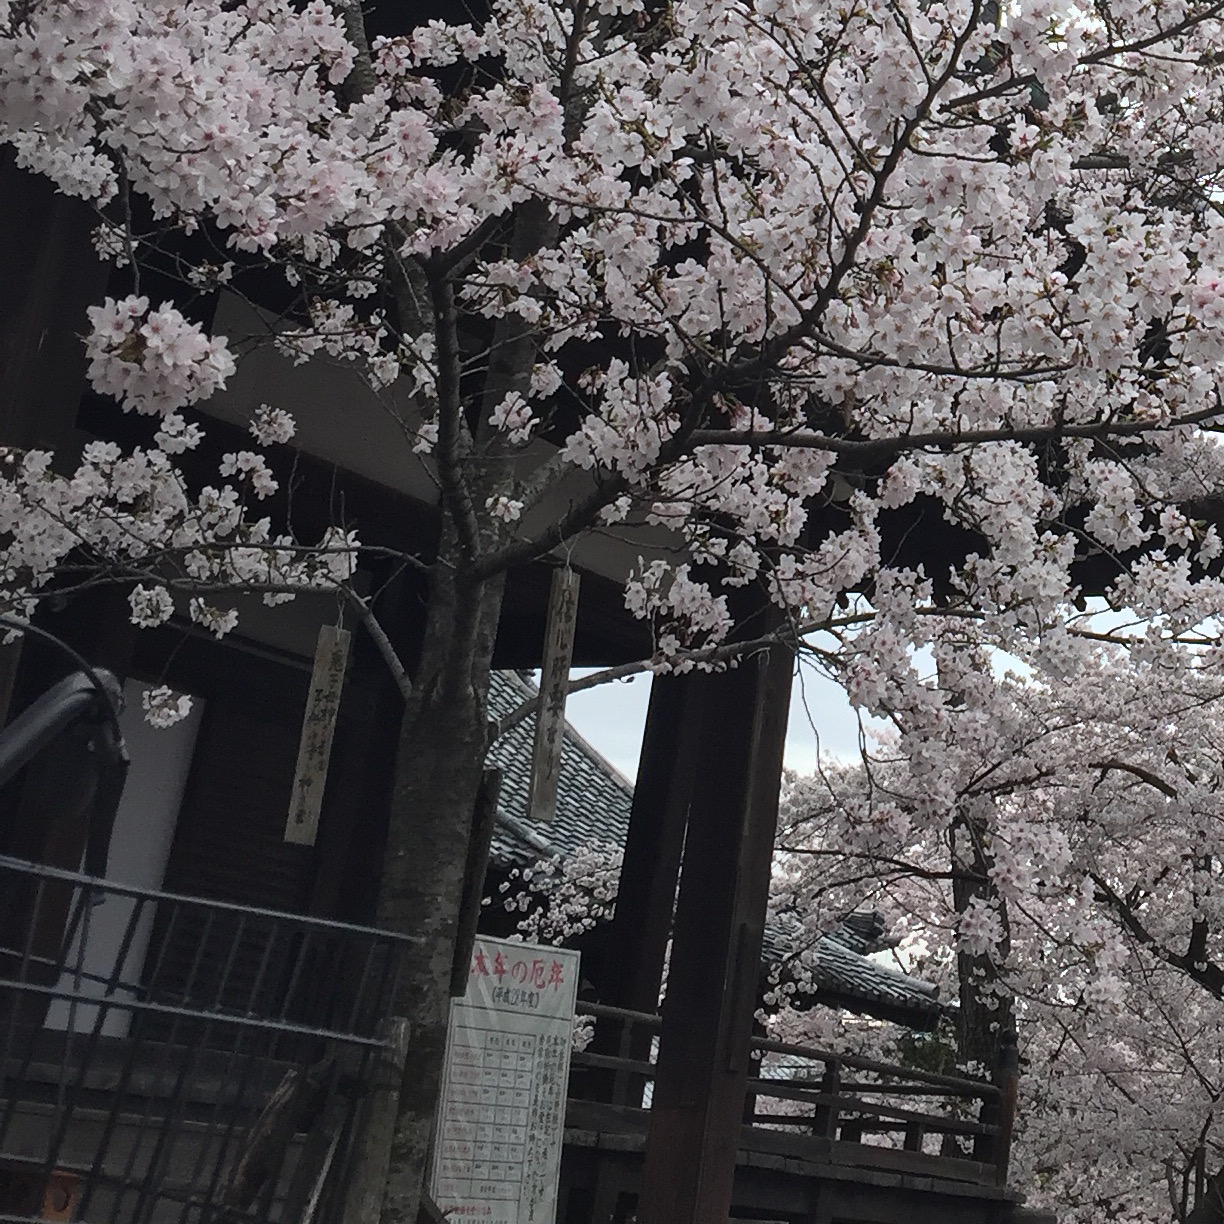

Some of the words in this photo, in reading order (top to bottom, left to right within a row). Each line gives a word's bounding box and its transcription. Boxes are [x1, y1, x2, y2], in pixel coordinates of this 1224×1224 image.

[471, 949, 564, 992] 本年の厄年
